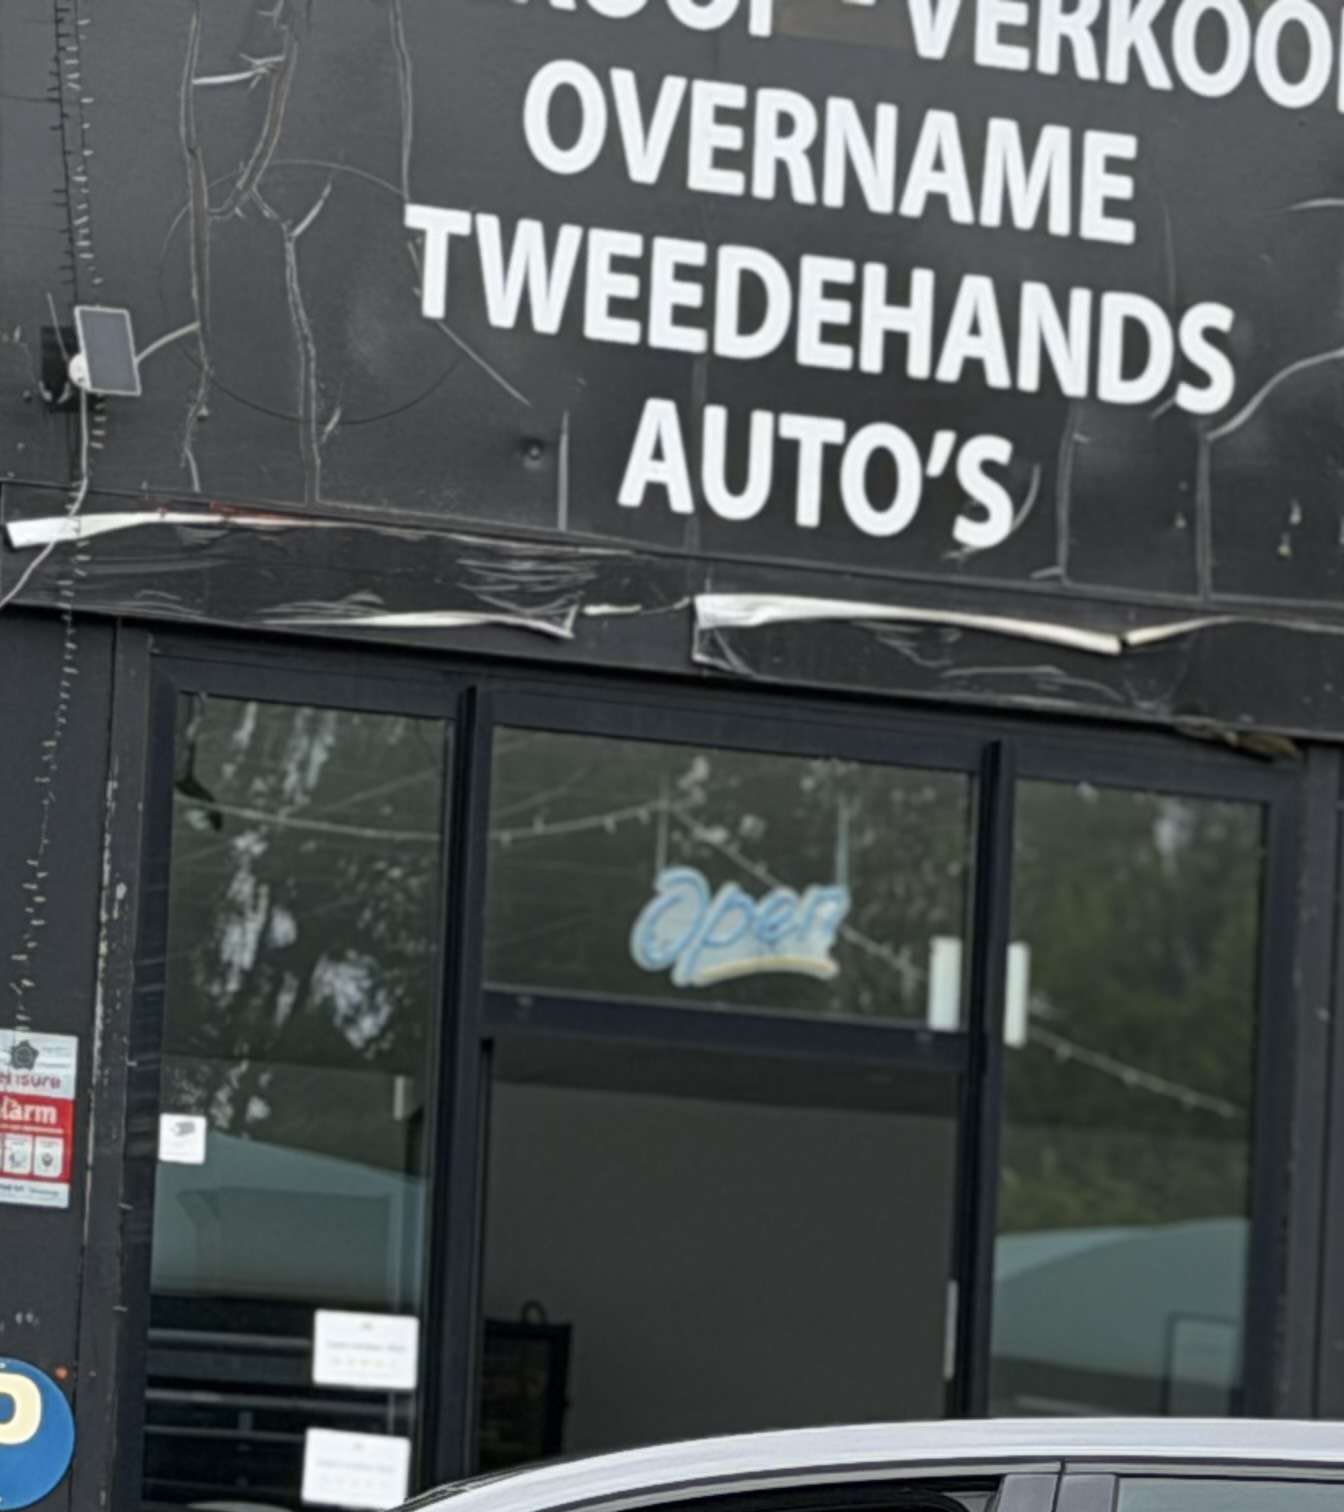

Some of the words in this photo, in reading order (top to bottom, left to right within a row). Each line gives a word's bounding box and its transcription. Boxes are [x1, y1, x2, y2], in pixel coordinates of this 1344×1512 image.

[523, 59, 1138, 244] OVERNAME
[404, 204, 1236, 415] TWEEDEHANDS
[630, 866, 851, 986] Open
